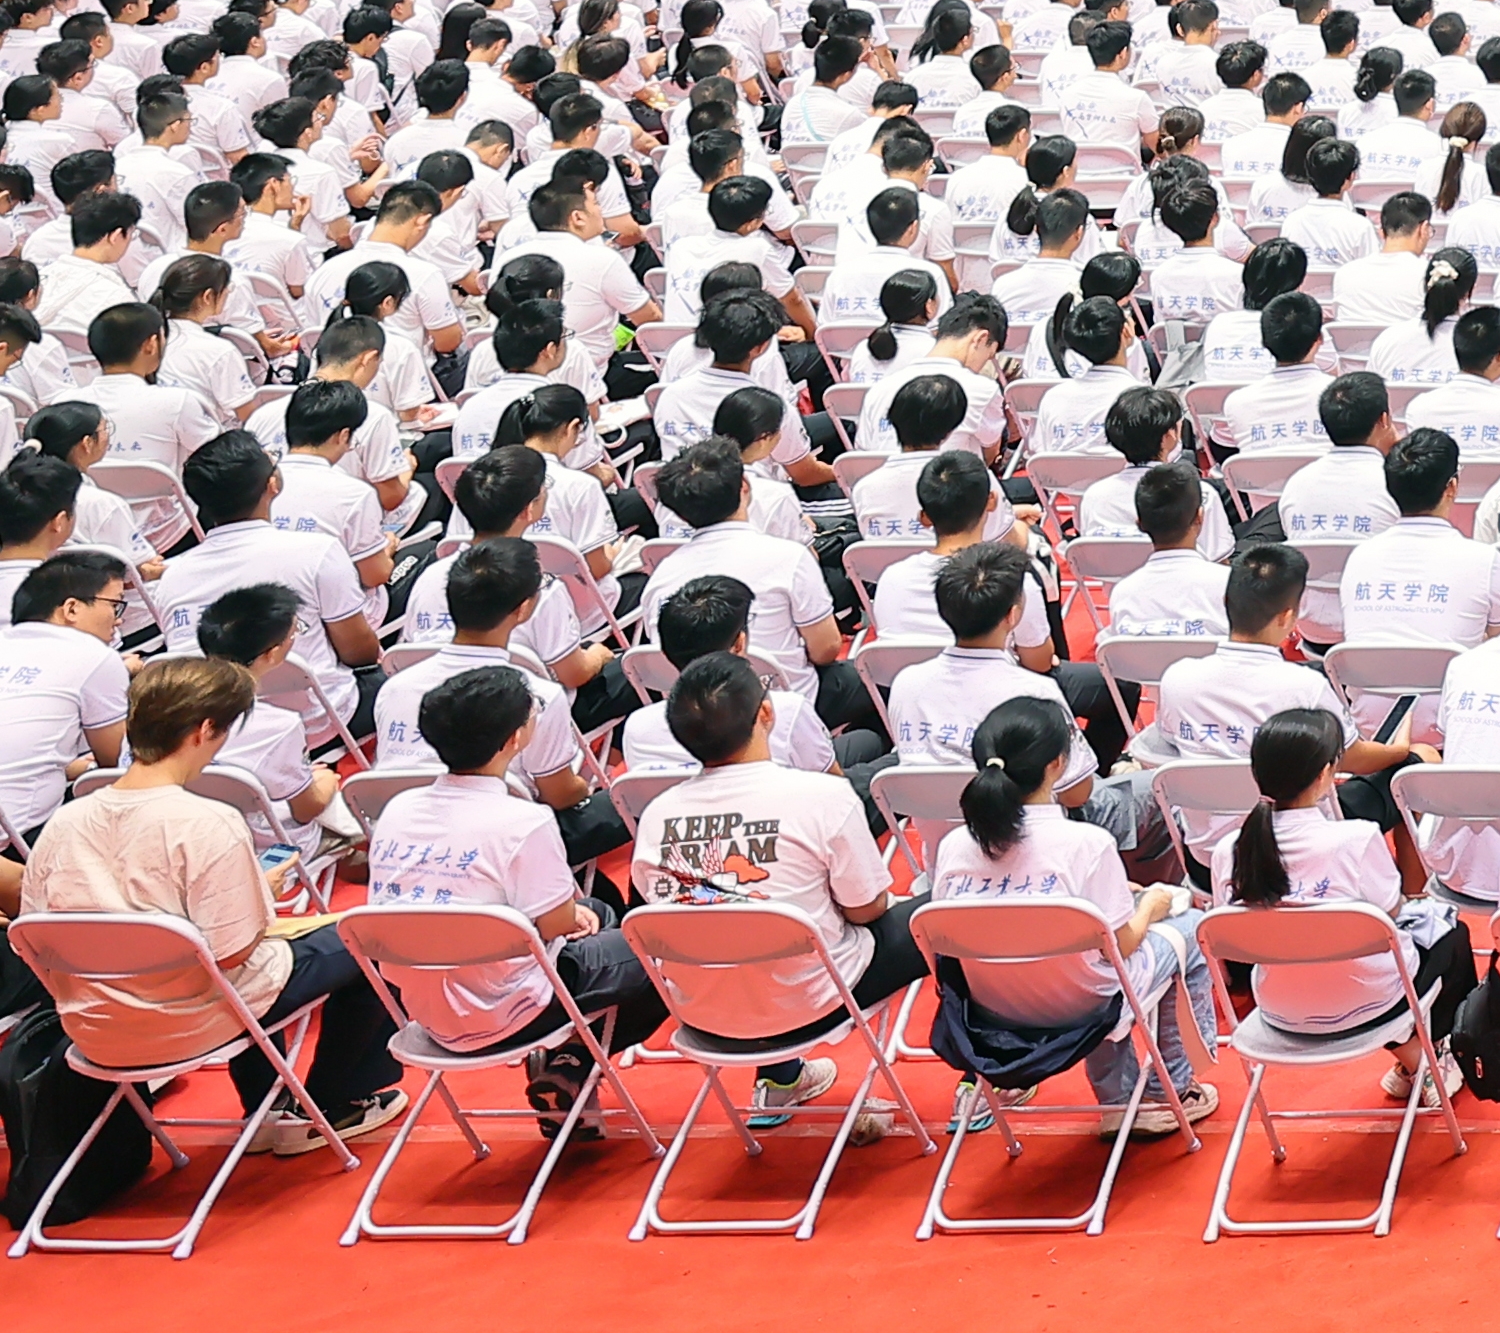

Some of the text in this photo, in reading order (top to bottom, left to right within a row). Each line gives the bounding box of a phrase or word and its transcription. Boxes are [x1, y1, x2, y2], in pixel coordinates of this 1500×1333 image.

[1291, 513, 1372, 532] 航天学院
[1354, 581, 1450, 603] 航天学院
[660, 811, 743, 846] KEEP
[743, 818, 780, 836] THE
